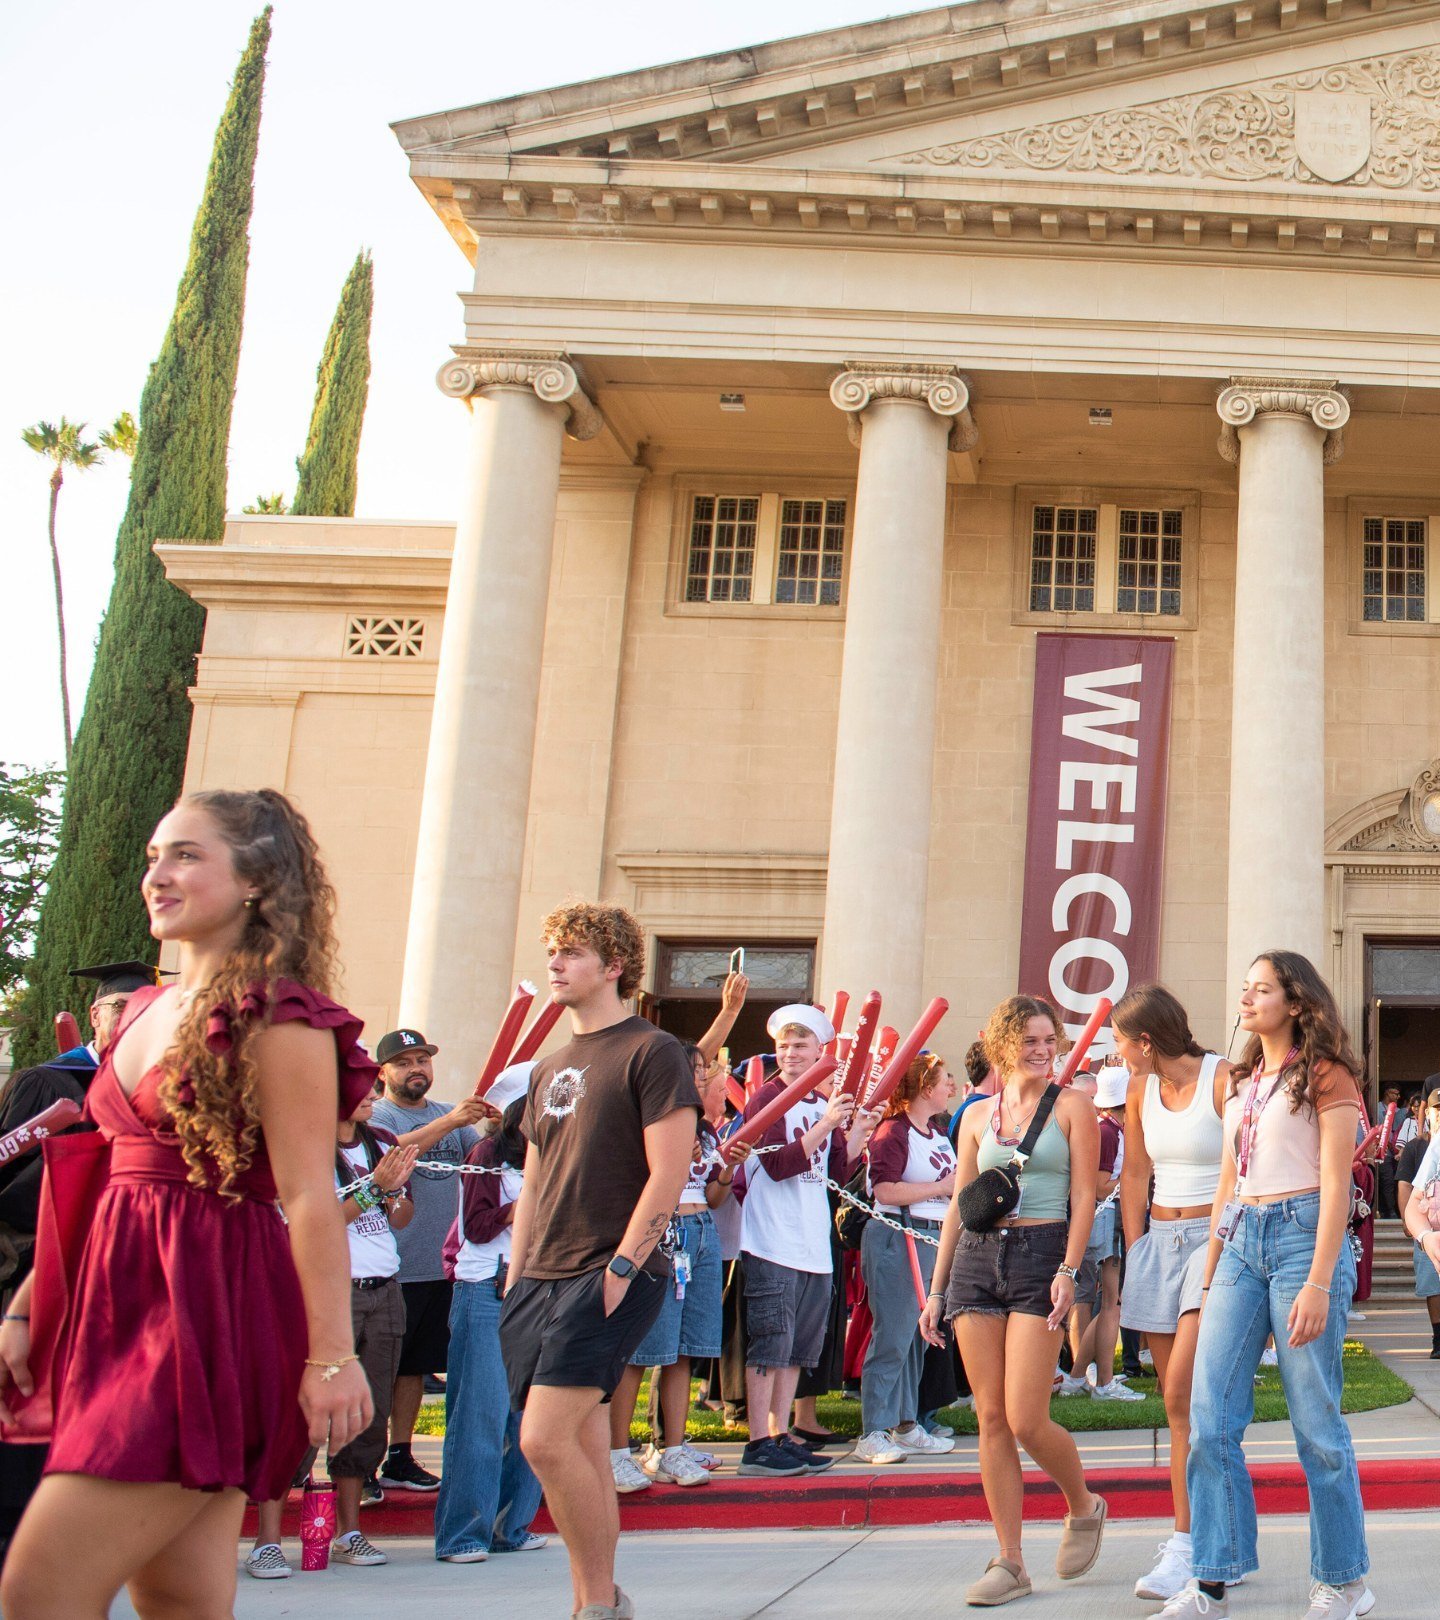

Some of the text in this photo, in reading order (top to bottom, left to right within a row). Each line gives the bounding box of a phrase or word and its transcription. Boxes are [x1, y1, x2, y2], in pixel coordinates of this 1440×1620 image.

[1311, 122, 1353, 136] THE
[1308, 141, 1358, 156] VINE
[400, 1031, 416, 1045] LA
